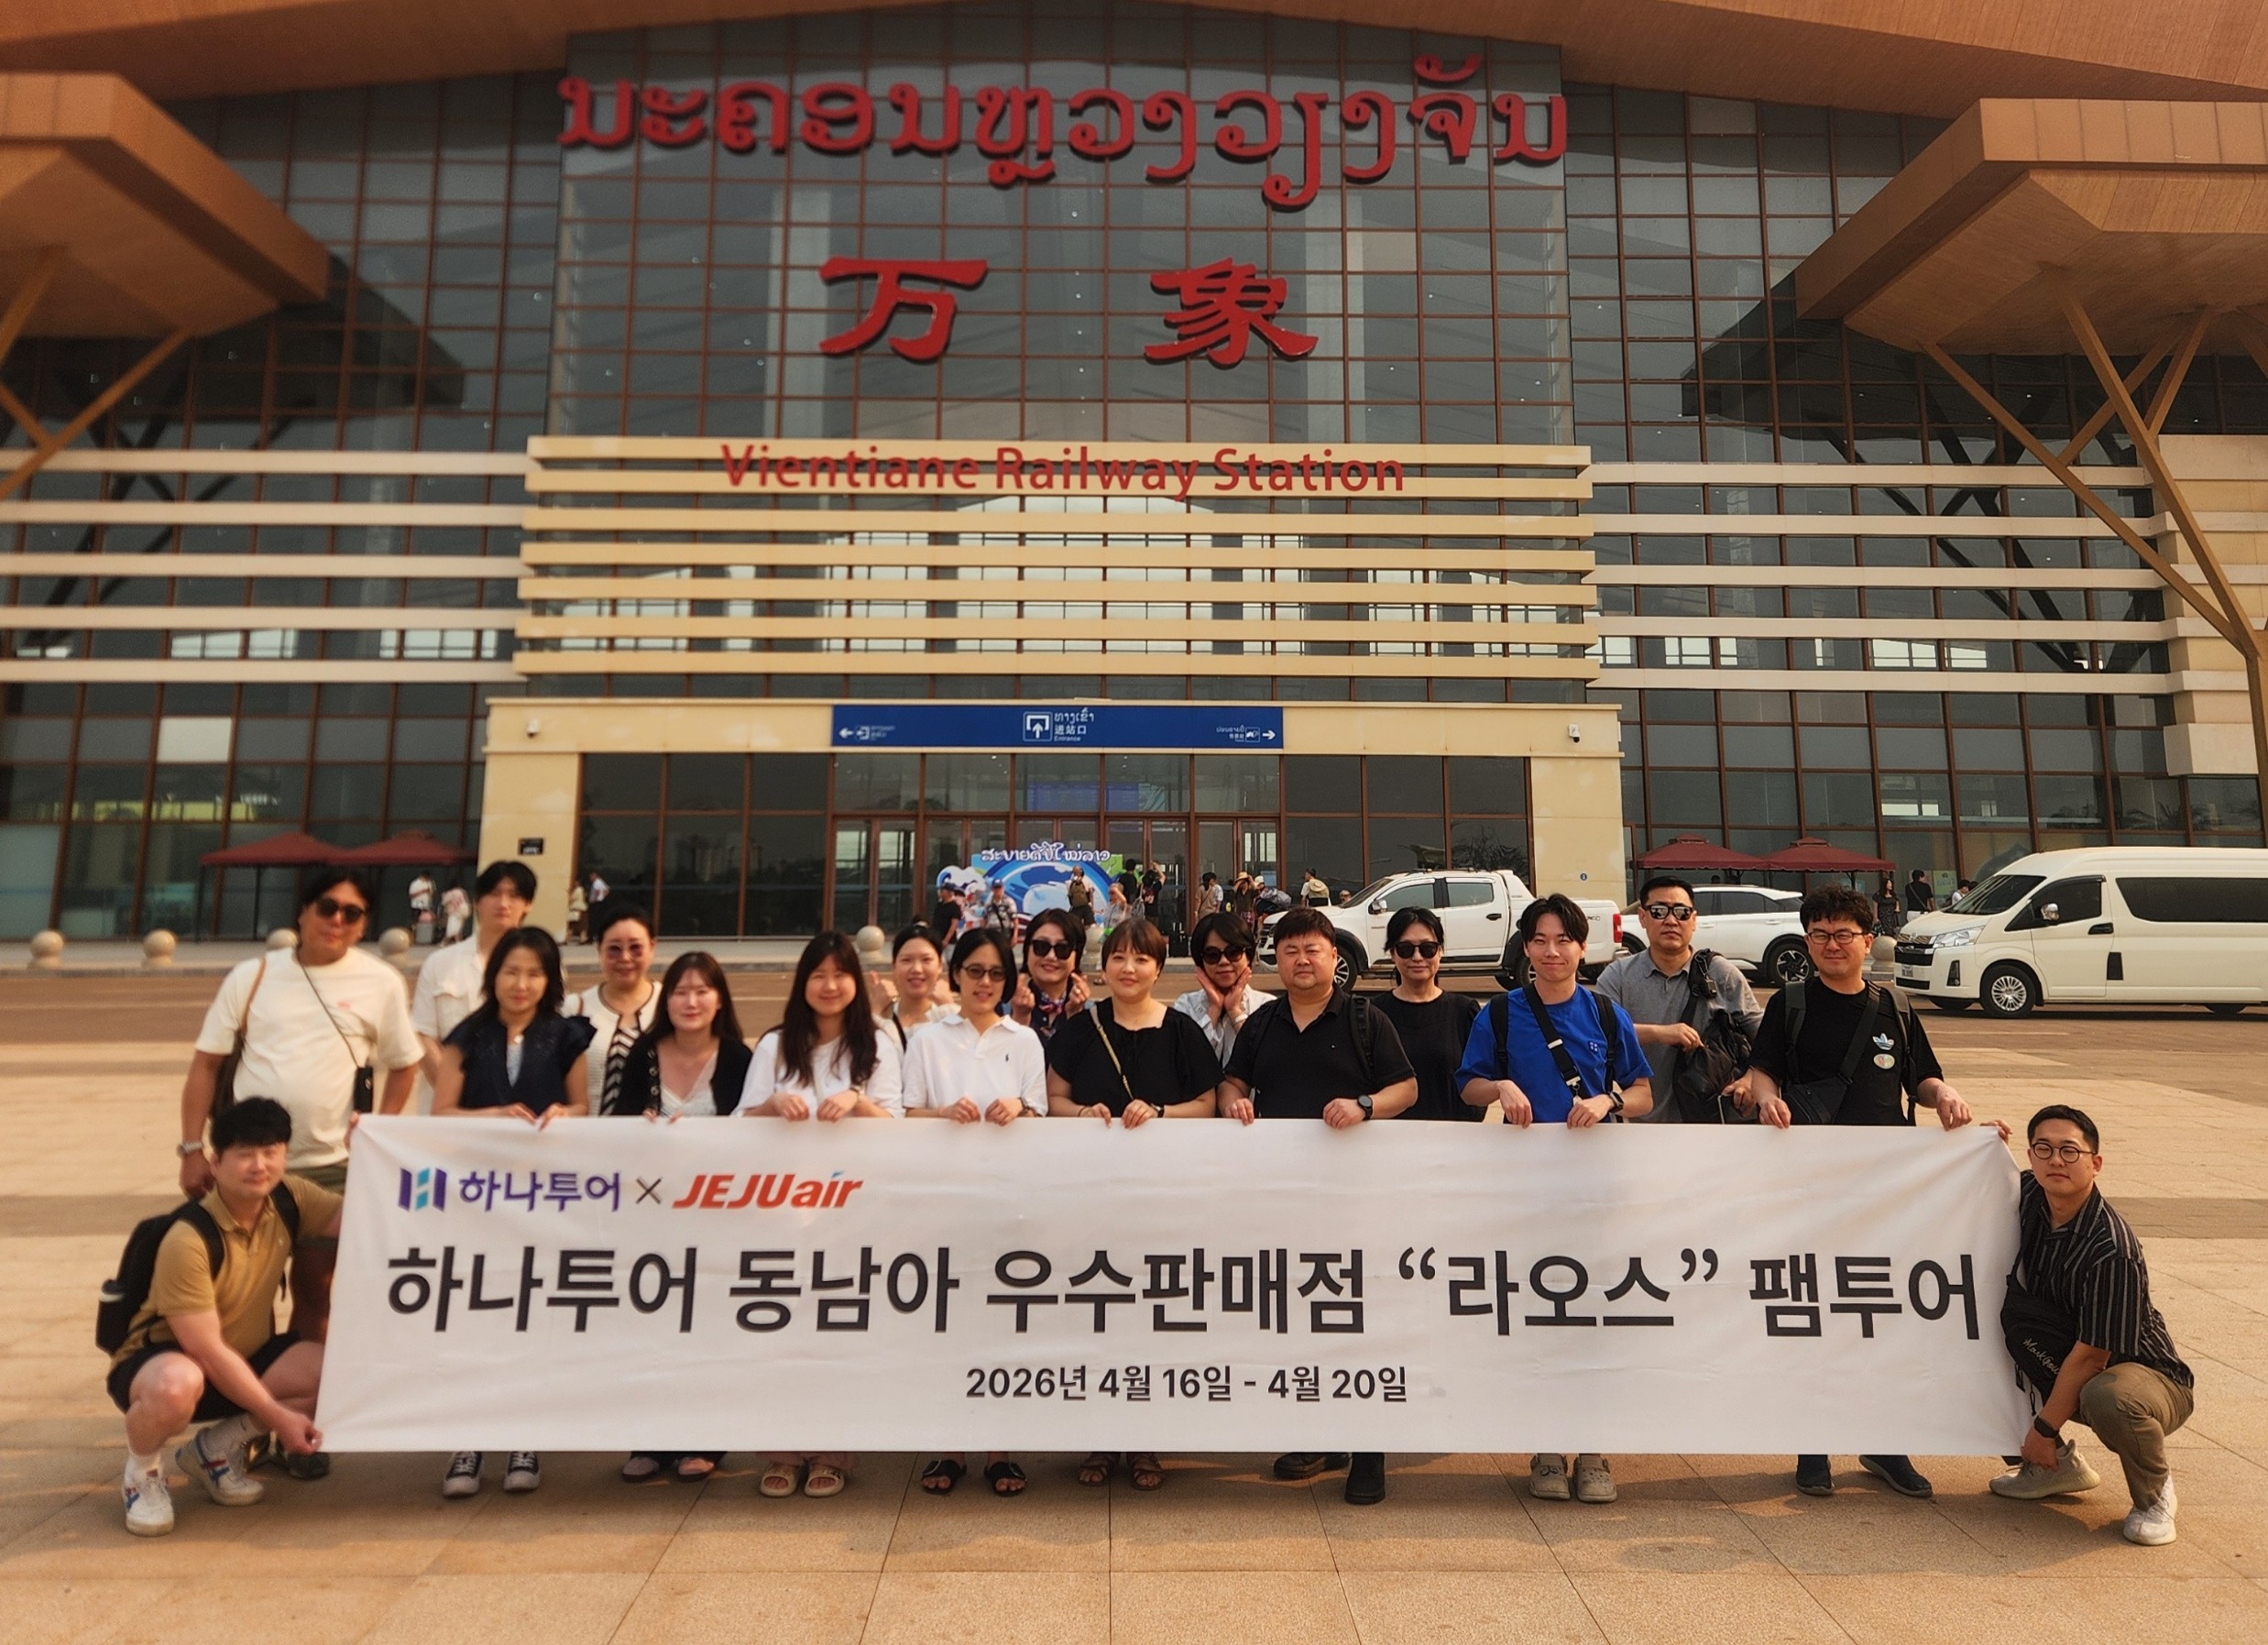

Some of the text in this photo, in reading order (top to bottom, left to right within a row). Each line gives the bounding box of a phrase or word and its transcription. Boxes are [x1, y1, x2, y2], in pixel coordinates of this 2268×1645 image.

[818, 257, 1317, 365] 万象
[721, 444, 1405, 501] Vientiane Railway Station
[459, 1169, 621, 1212] 하나투어
[388, 1245, 698, 1333] 하나투어
[729, 1246, 960, 1332] 동남아
[986, 1247, 1364, 1334] 우수판매점
[1748, 1253, 1980, 1341] 팸투어
[966, 1365, 1087, 1401] 2026년
[1098, 1365, 1151, 1402] 4월
[1162, 1365, 1232, 1402] 16일
[1267, 1365, 1320, 1402] 4월
[1331, 1366, 1407, 1403] 20일
